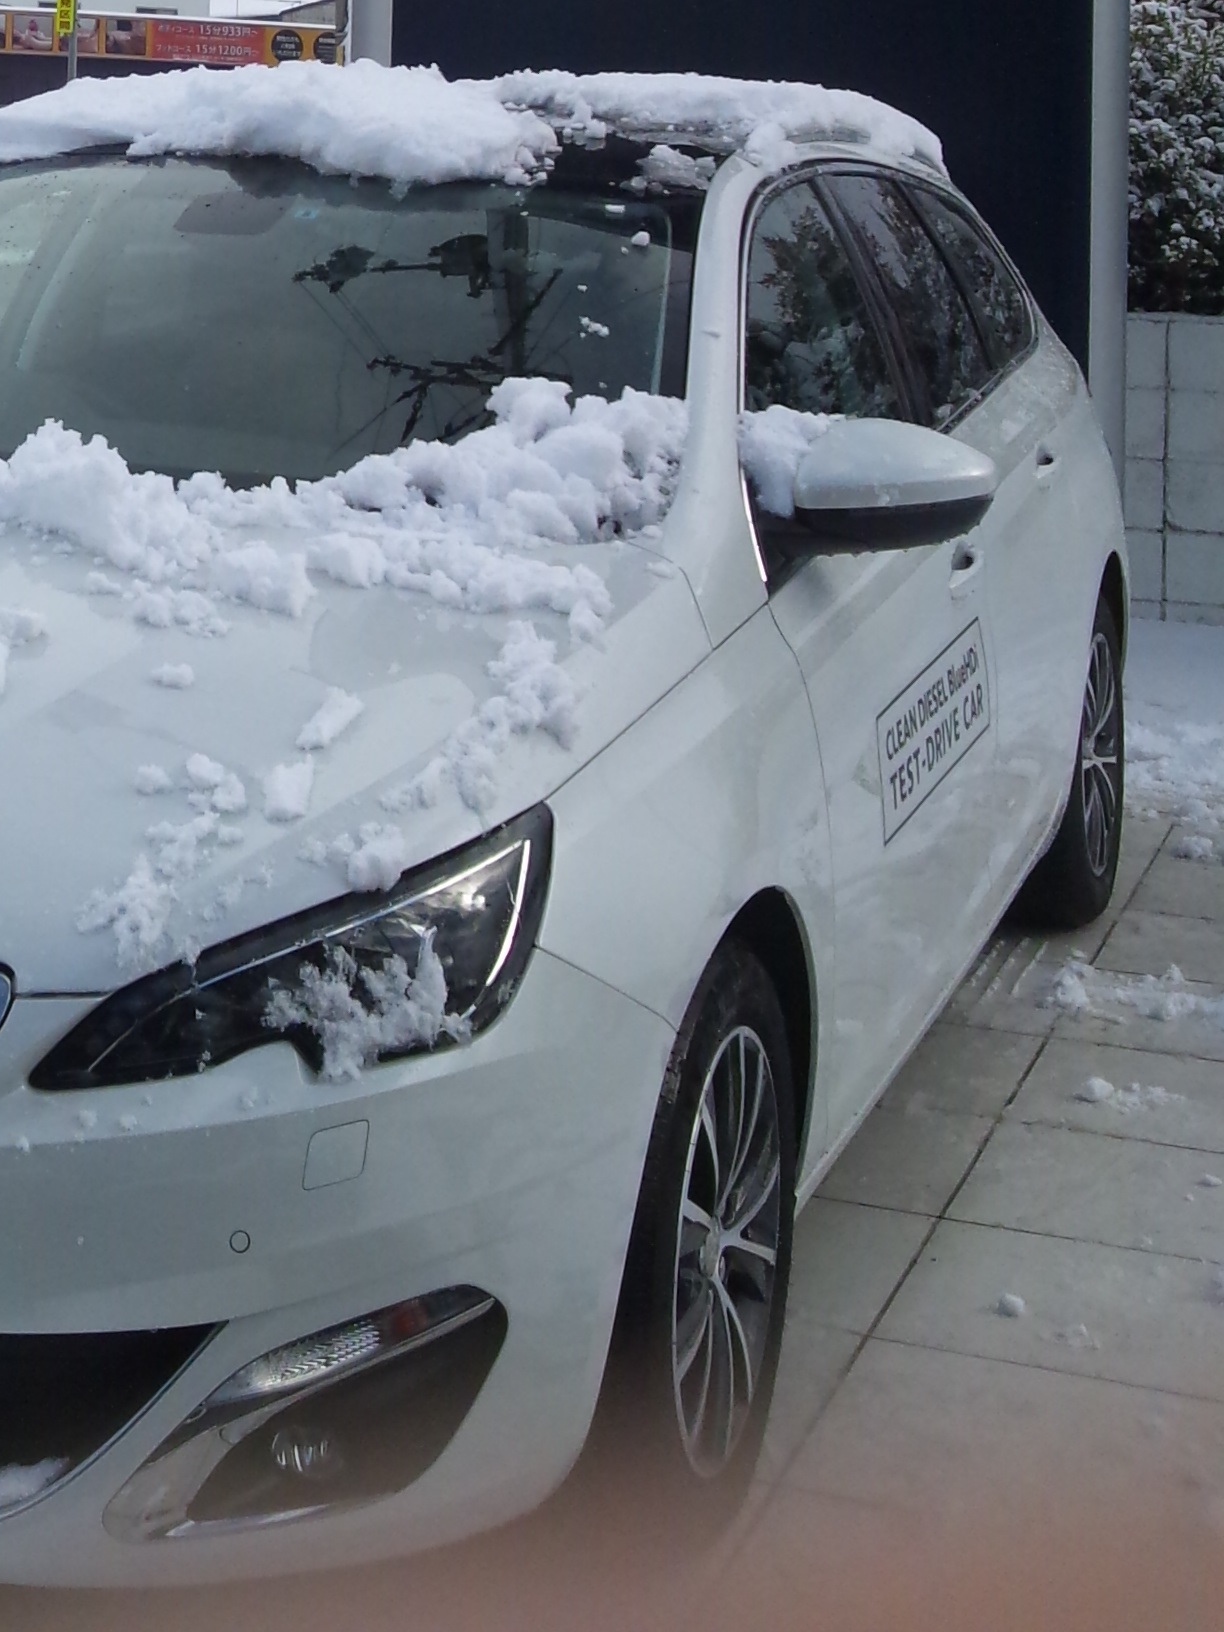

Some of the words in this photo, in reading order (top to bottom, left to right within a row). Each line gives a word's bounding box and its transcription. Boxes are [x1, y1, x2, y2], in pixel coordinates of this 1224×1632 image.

[886, 705, 918, 761] CLEAN
[917, 676, 949, 729] DIESEL
[947, 643, 980, 697] BlueHDi
[889, 706, 961, 810] TEST-DRIVE
[962, 683, 984, 731] CAR
